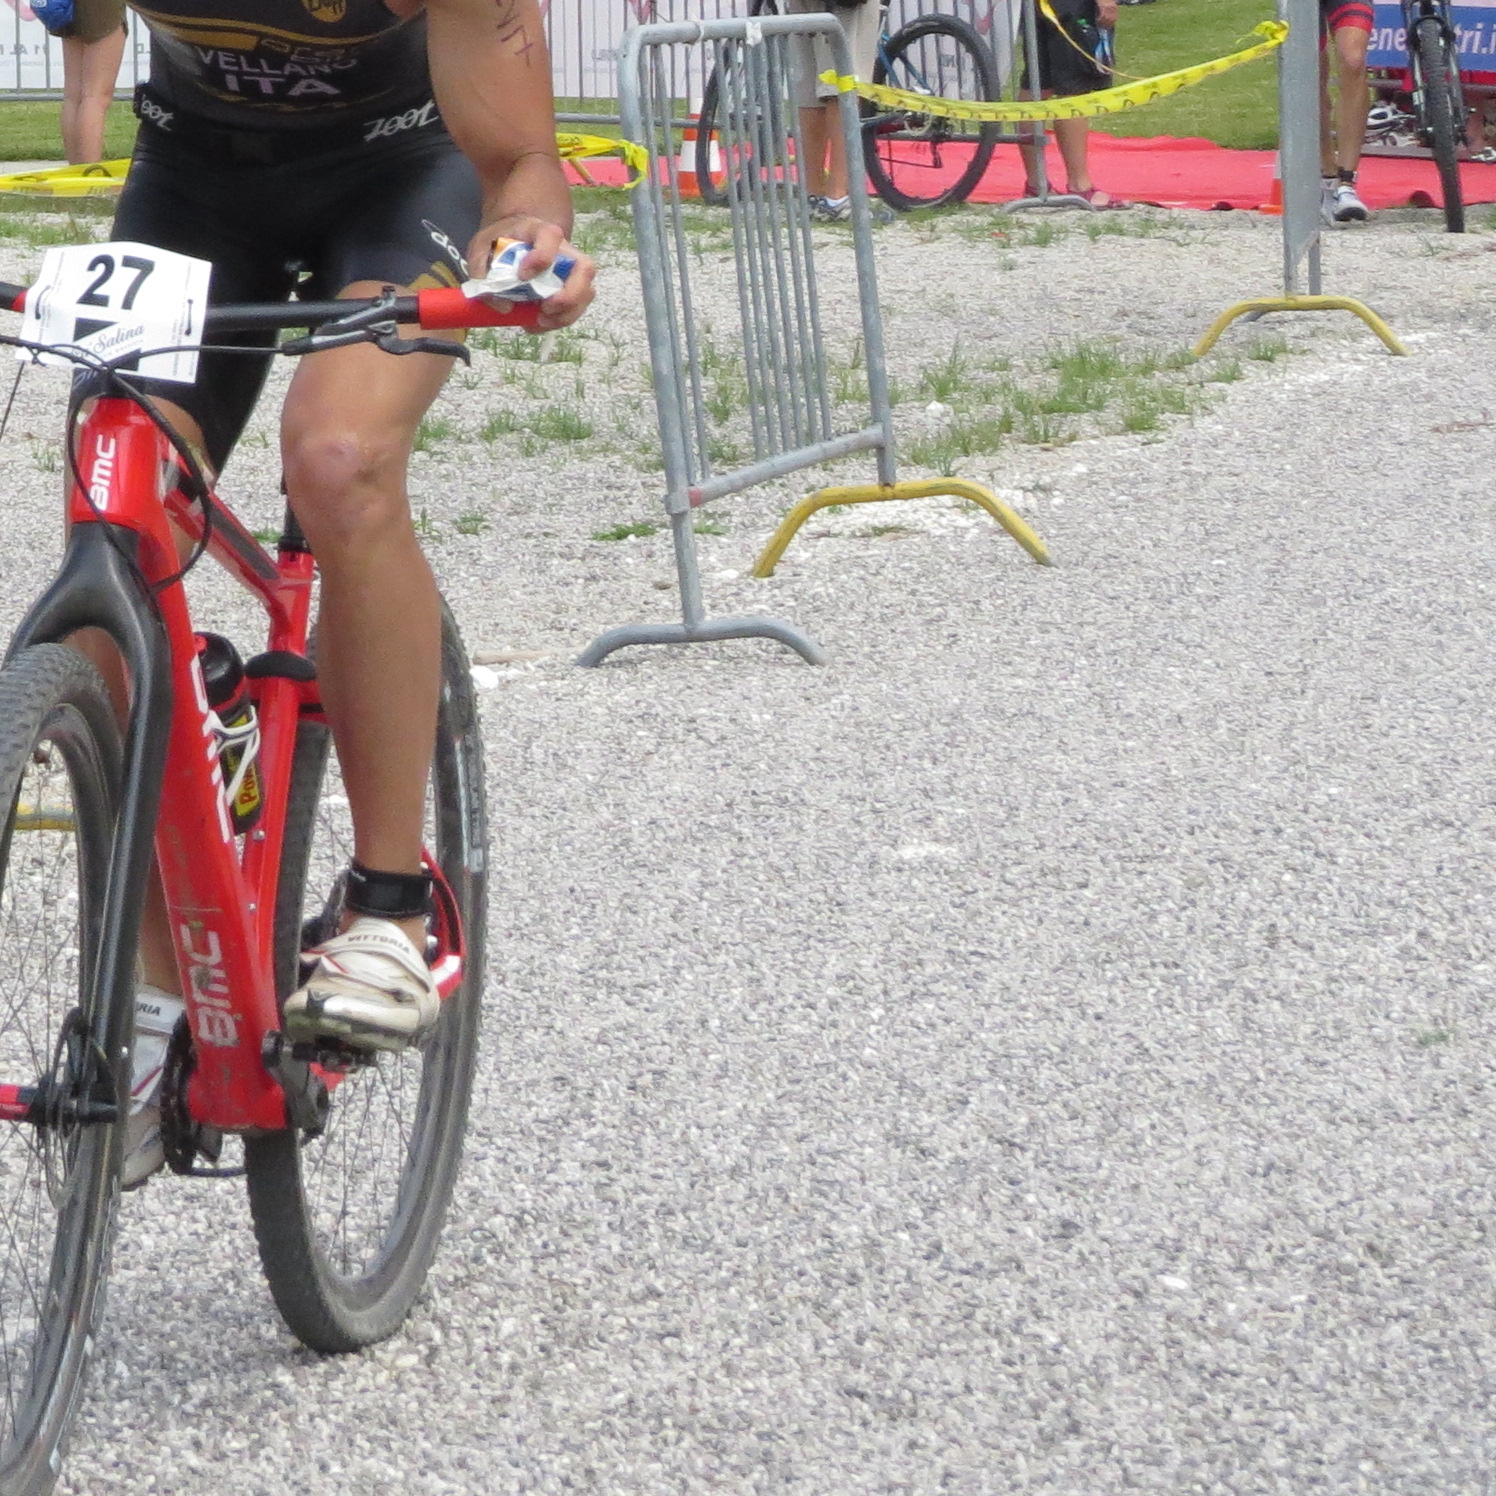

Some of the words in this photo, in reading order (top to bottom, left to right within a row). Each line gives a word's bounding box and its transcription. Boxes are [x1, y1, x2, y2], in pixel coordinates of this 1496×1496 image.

[224, 74, 342, 97] ITA
[76, 253, 155, 310] 27
[93, 325, 145, 354] Salina
[347, 933, 411, 955] VITTORIA
